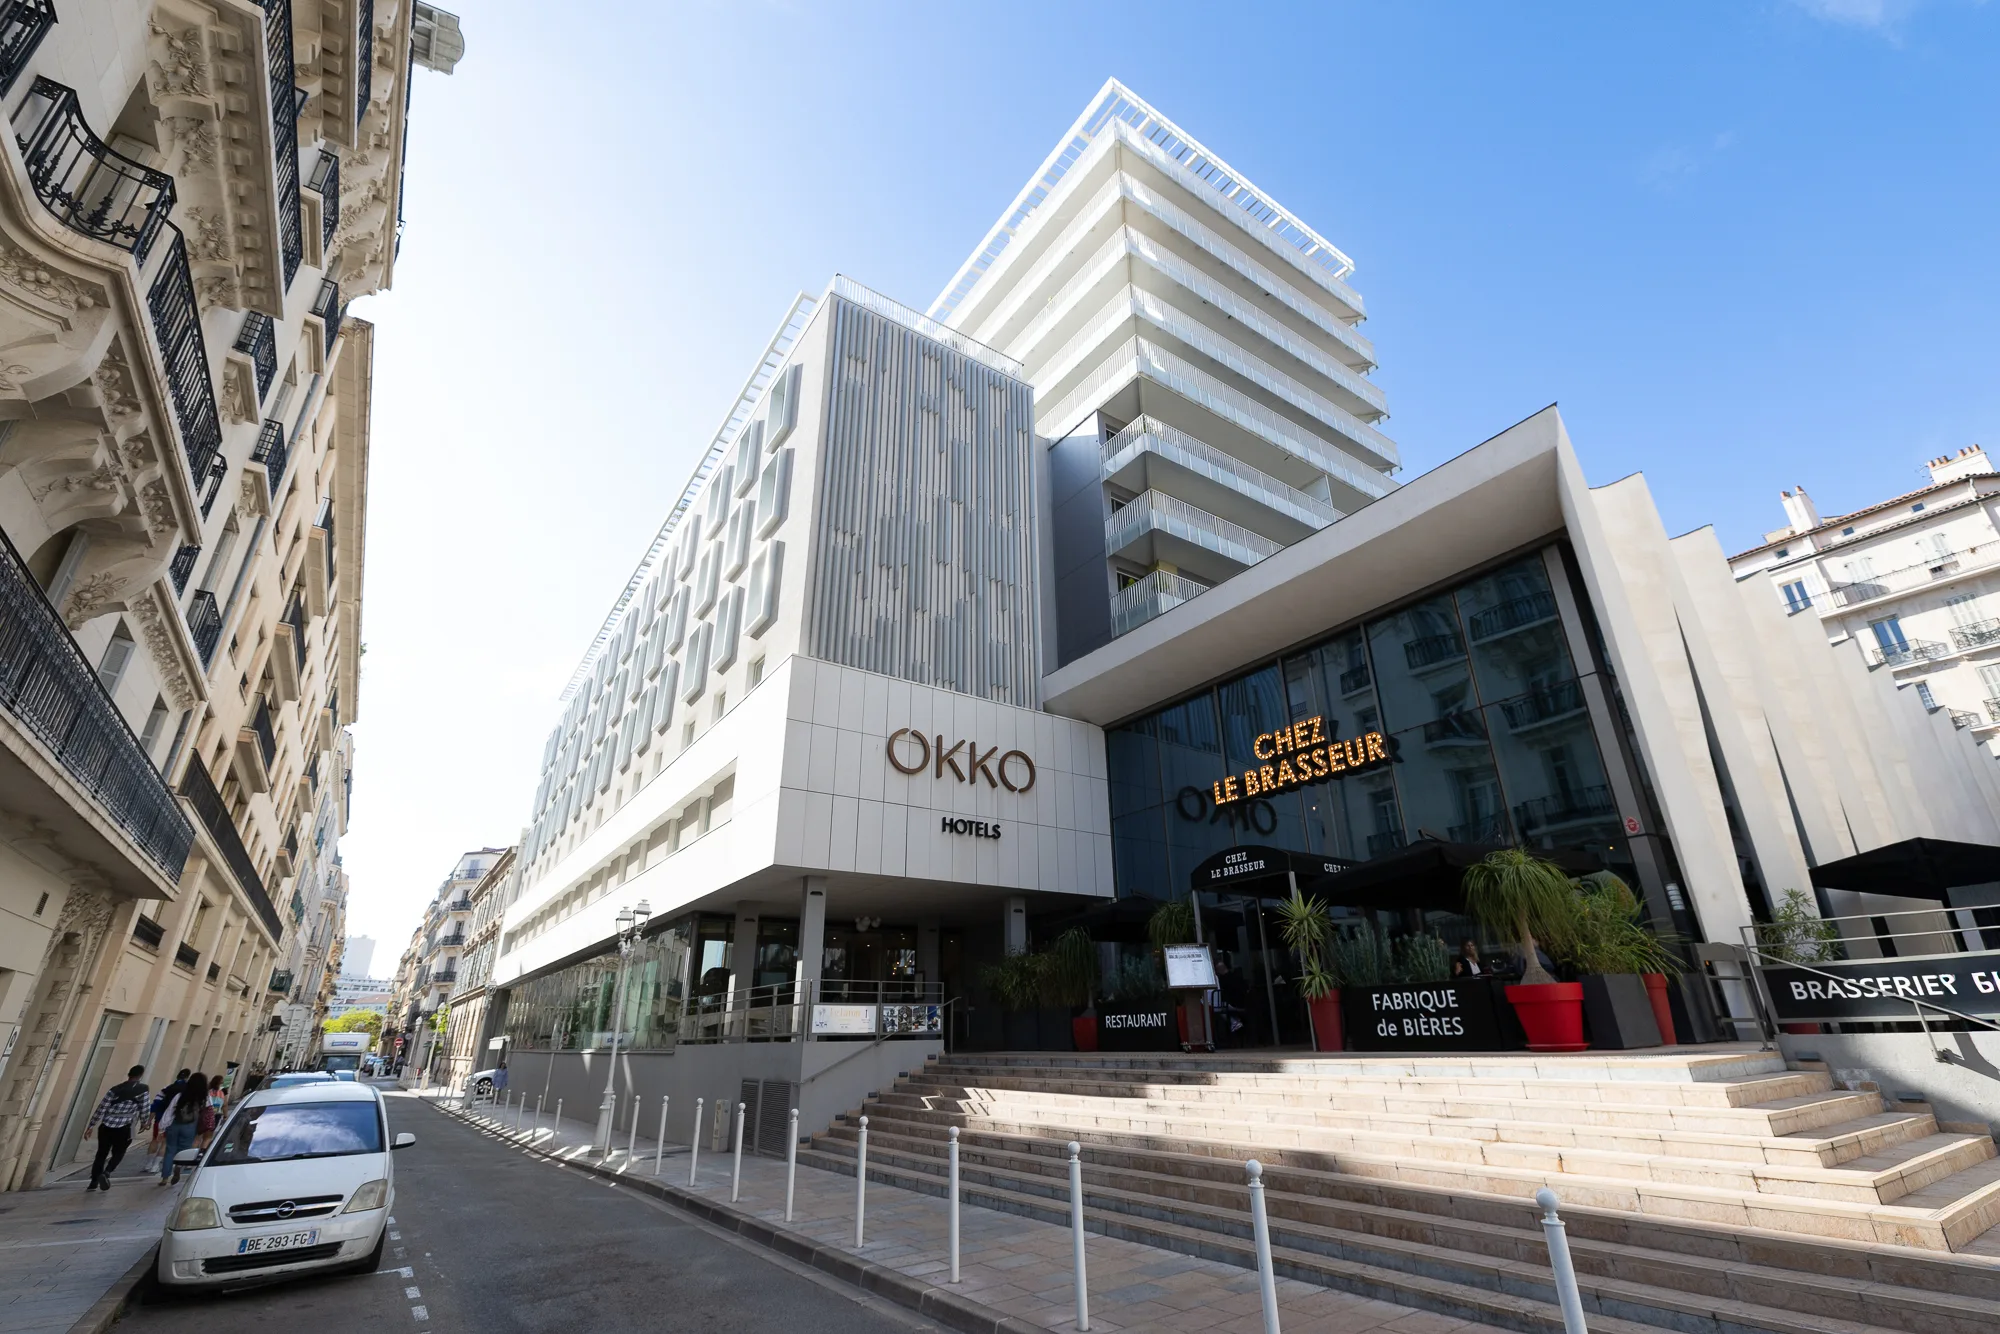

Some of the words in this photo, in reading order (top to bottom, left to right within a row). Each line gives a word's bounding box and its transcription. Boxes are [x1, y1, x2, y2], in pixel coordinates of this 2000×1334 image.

[1254, 715, 1326, 760] CHEZ
[887, 728, 1036, 793] OKKO
[1213, 775, 1239, 805] LE
[1244, 731, 1387, 796] BRASSEUR
[942, 817, 1001, 839] HOTELS
[1211, 869, 1221, 878] LE
[1223, 860, 1265, 876] BRASSEUR
[1225, 852, 1247, 864] CHEZ
[1372, 989, 1458, 1012] FABRIQUE
[1105, 1013, 1167, 1028] RESTAURANT
[1377, 1019, 1397, 1036] de
[1403, 1013, 1464, 1035] BIÈRES
[247, 1233, 308, 1251] BE-293-FG
